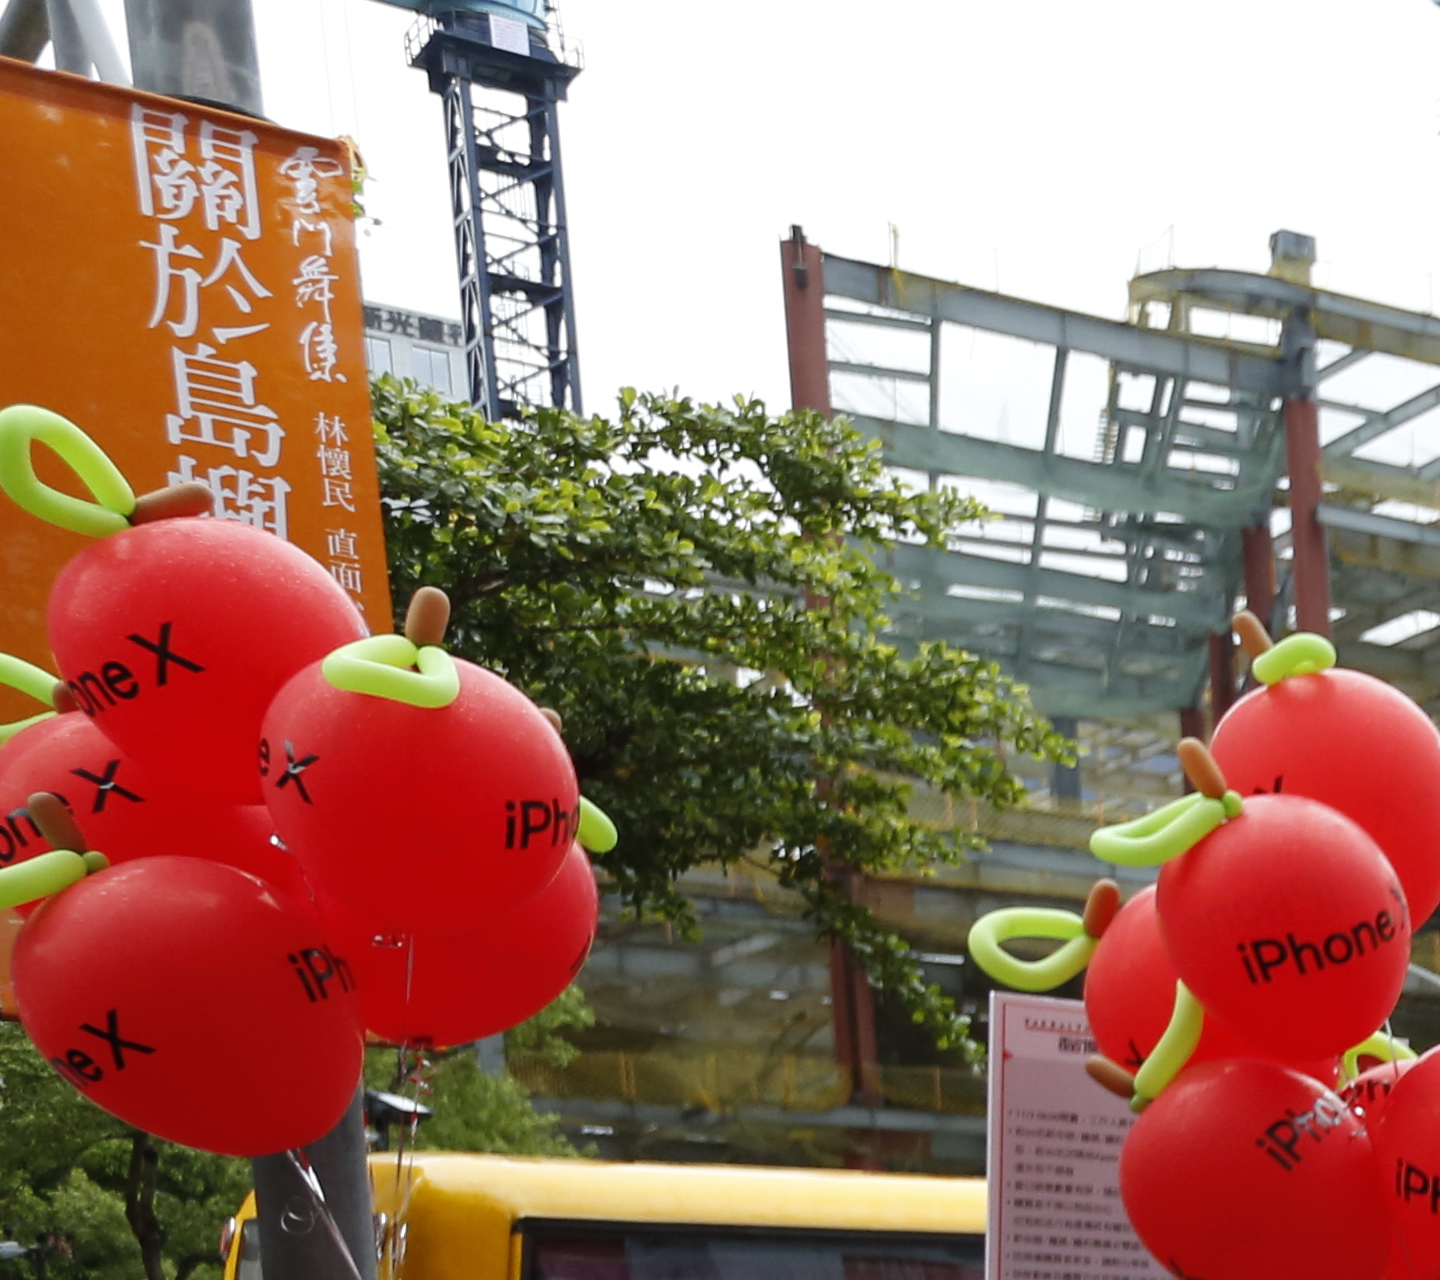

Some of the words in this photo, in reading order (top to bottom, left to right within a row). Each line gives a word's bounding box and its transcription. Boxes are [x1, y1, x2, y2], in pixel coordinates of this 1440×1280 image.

[313, 411, 357, 513] 林懷民
[128, 622, 206, 688] X
[71, 759, 145, 814] X
[1236, 915, 1397, 987] iPhone
[79, 1008, 156, 1071] X
